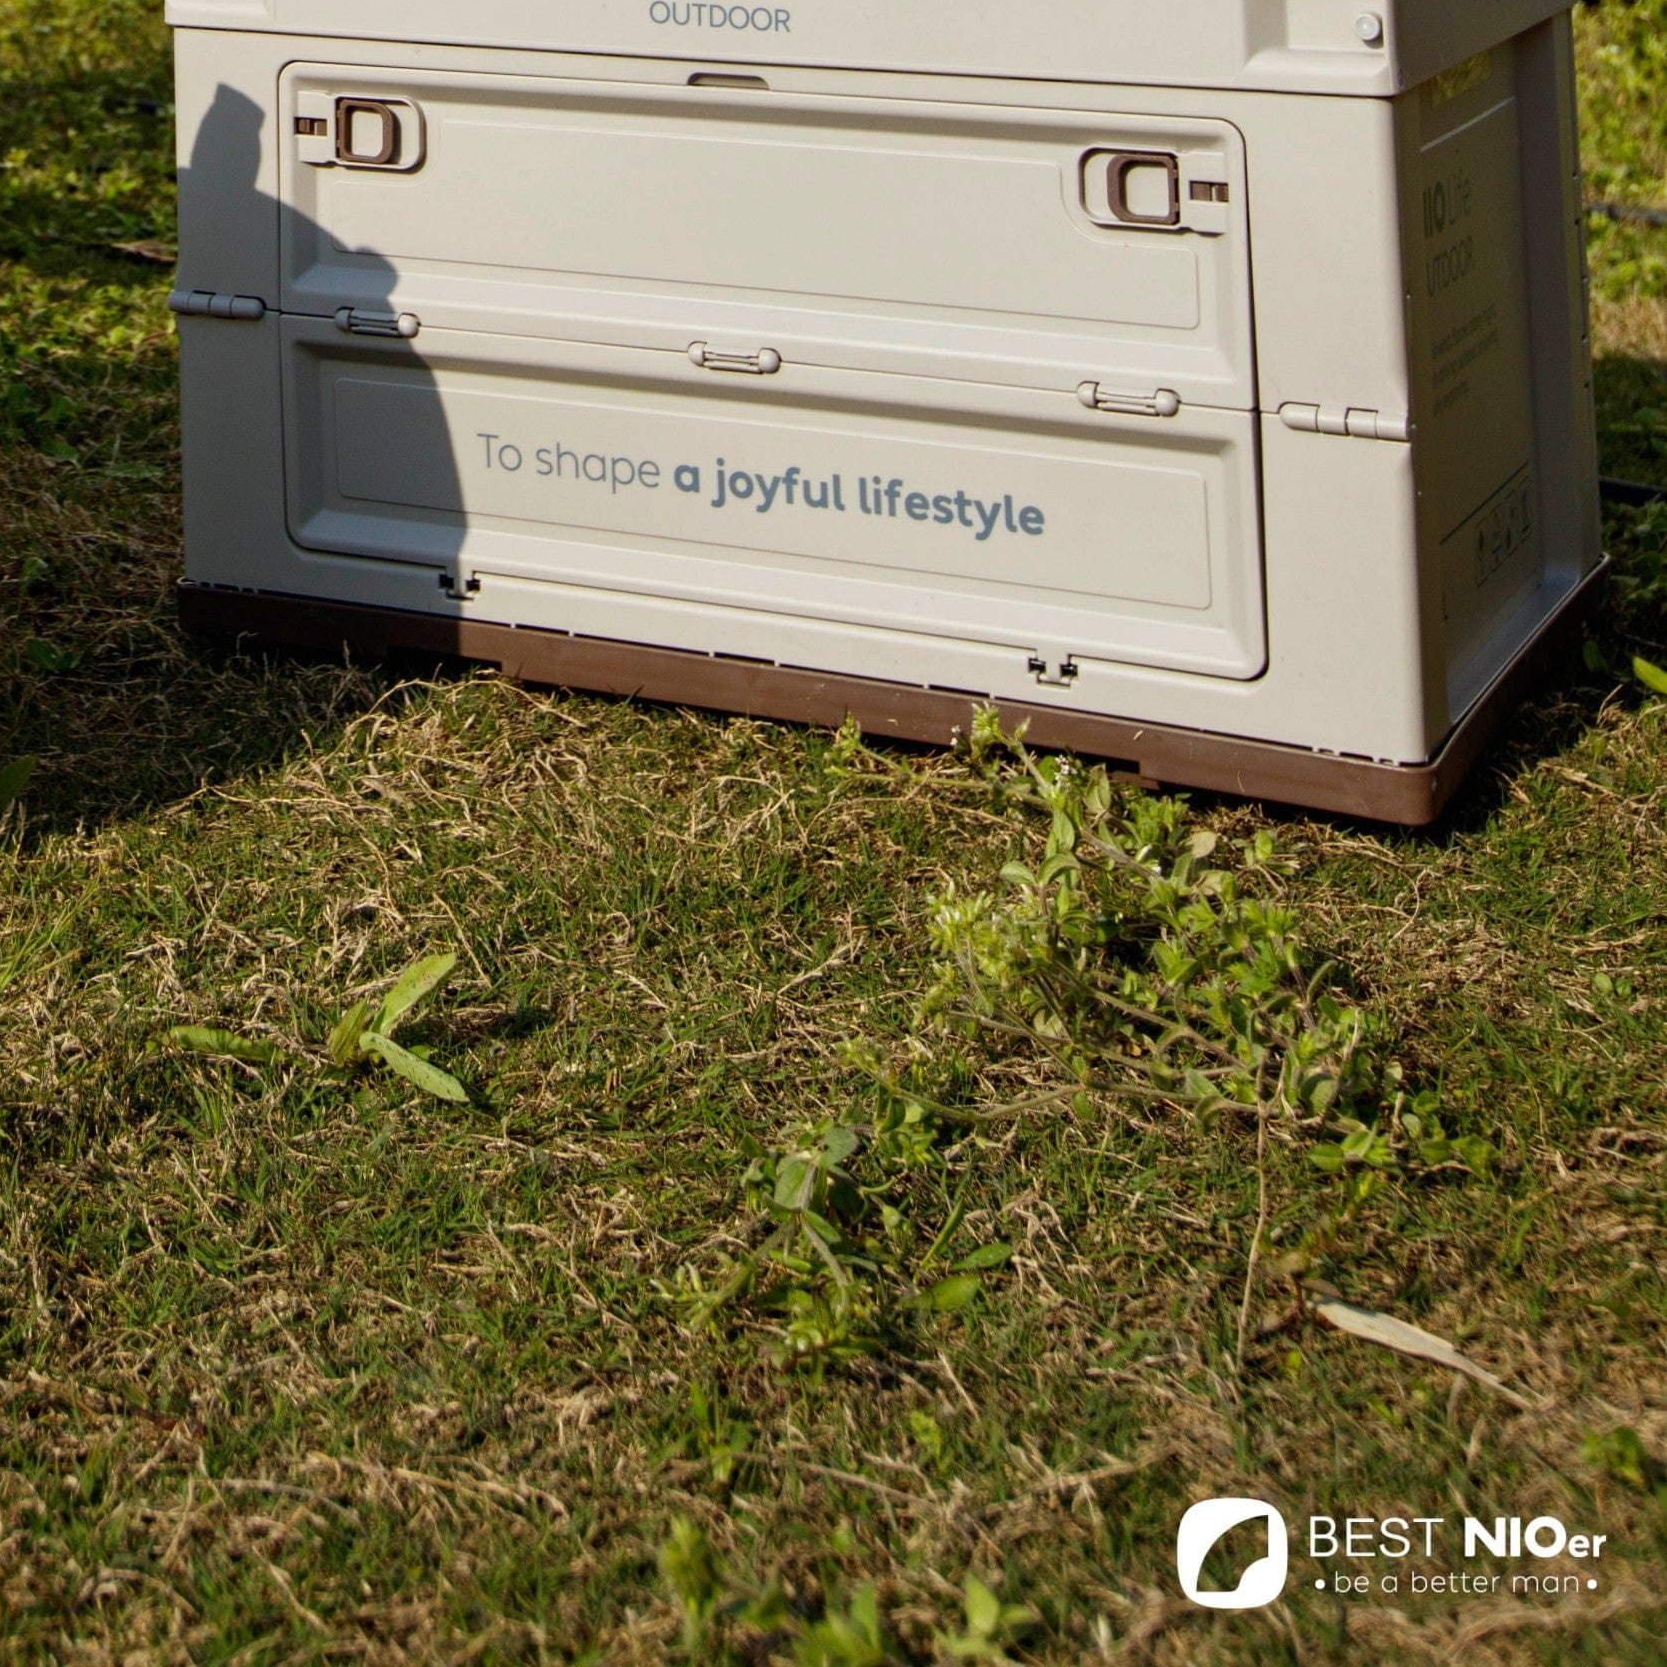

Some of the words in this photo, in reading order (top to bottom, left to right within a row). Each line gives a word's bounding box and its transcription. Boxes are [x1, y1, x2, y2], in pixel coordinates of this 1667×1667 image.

[649, 0, 791, 33] OUTDOOR
[476, 433, 523, 472] To
[534, 442, 661, 495] shape
[672, 463, 701, 493] a
[711, 457, 846, 512] joyful
[857, 474, 1046, 540] lifestyle
